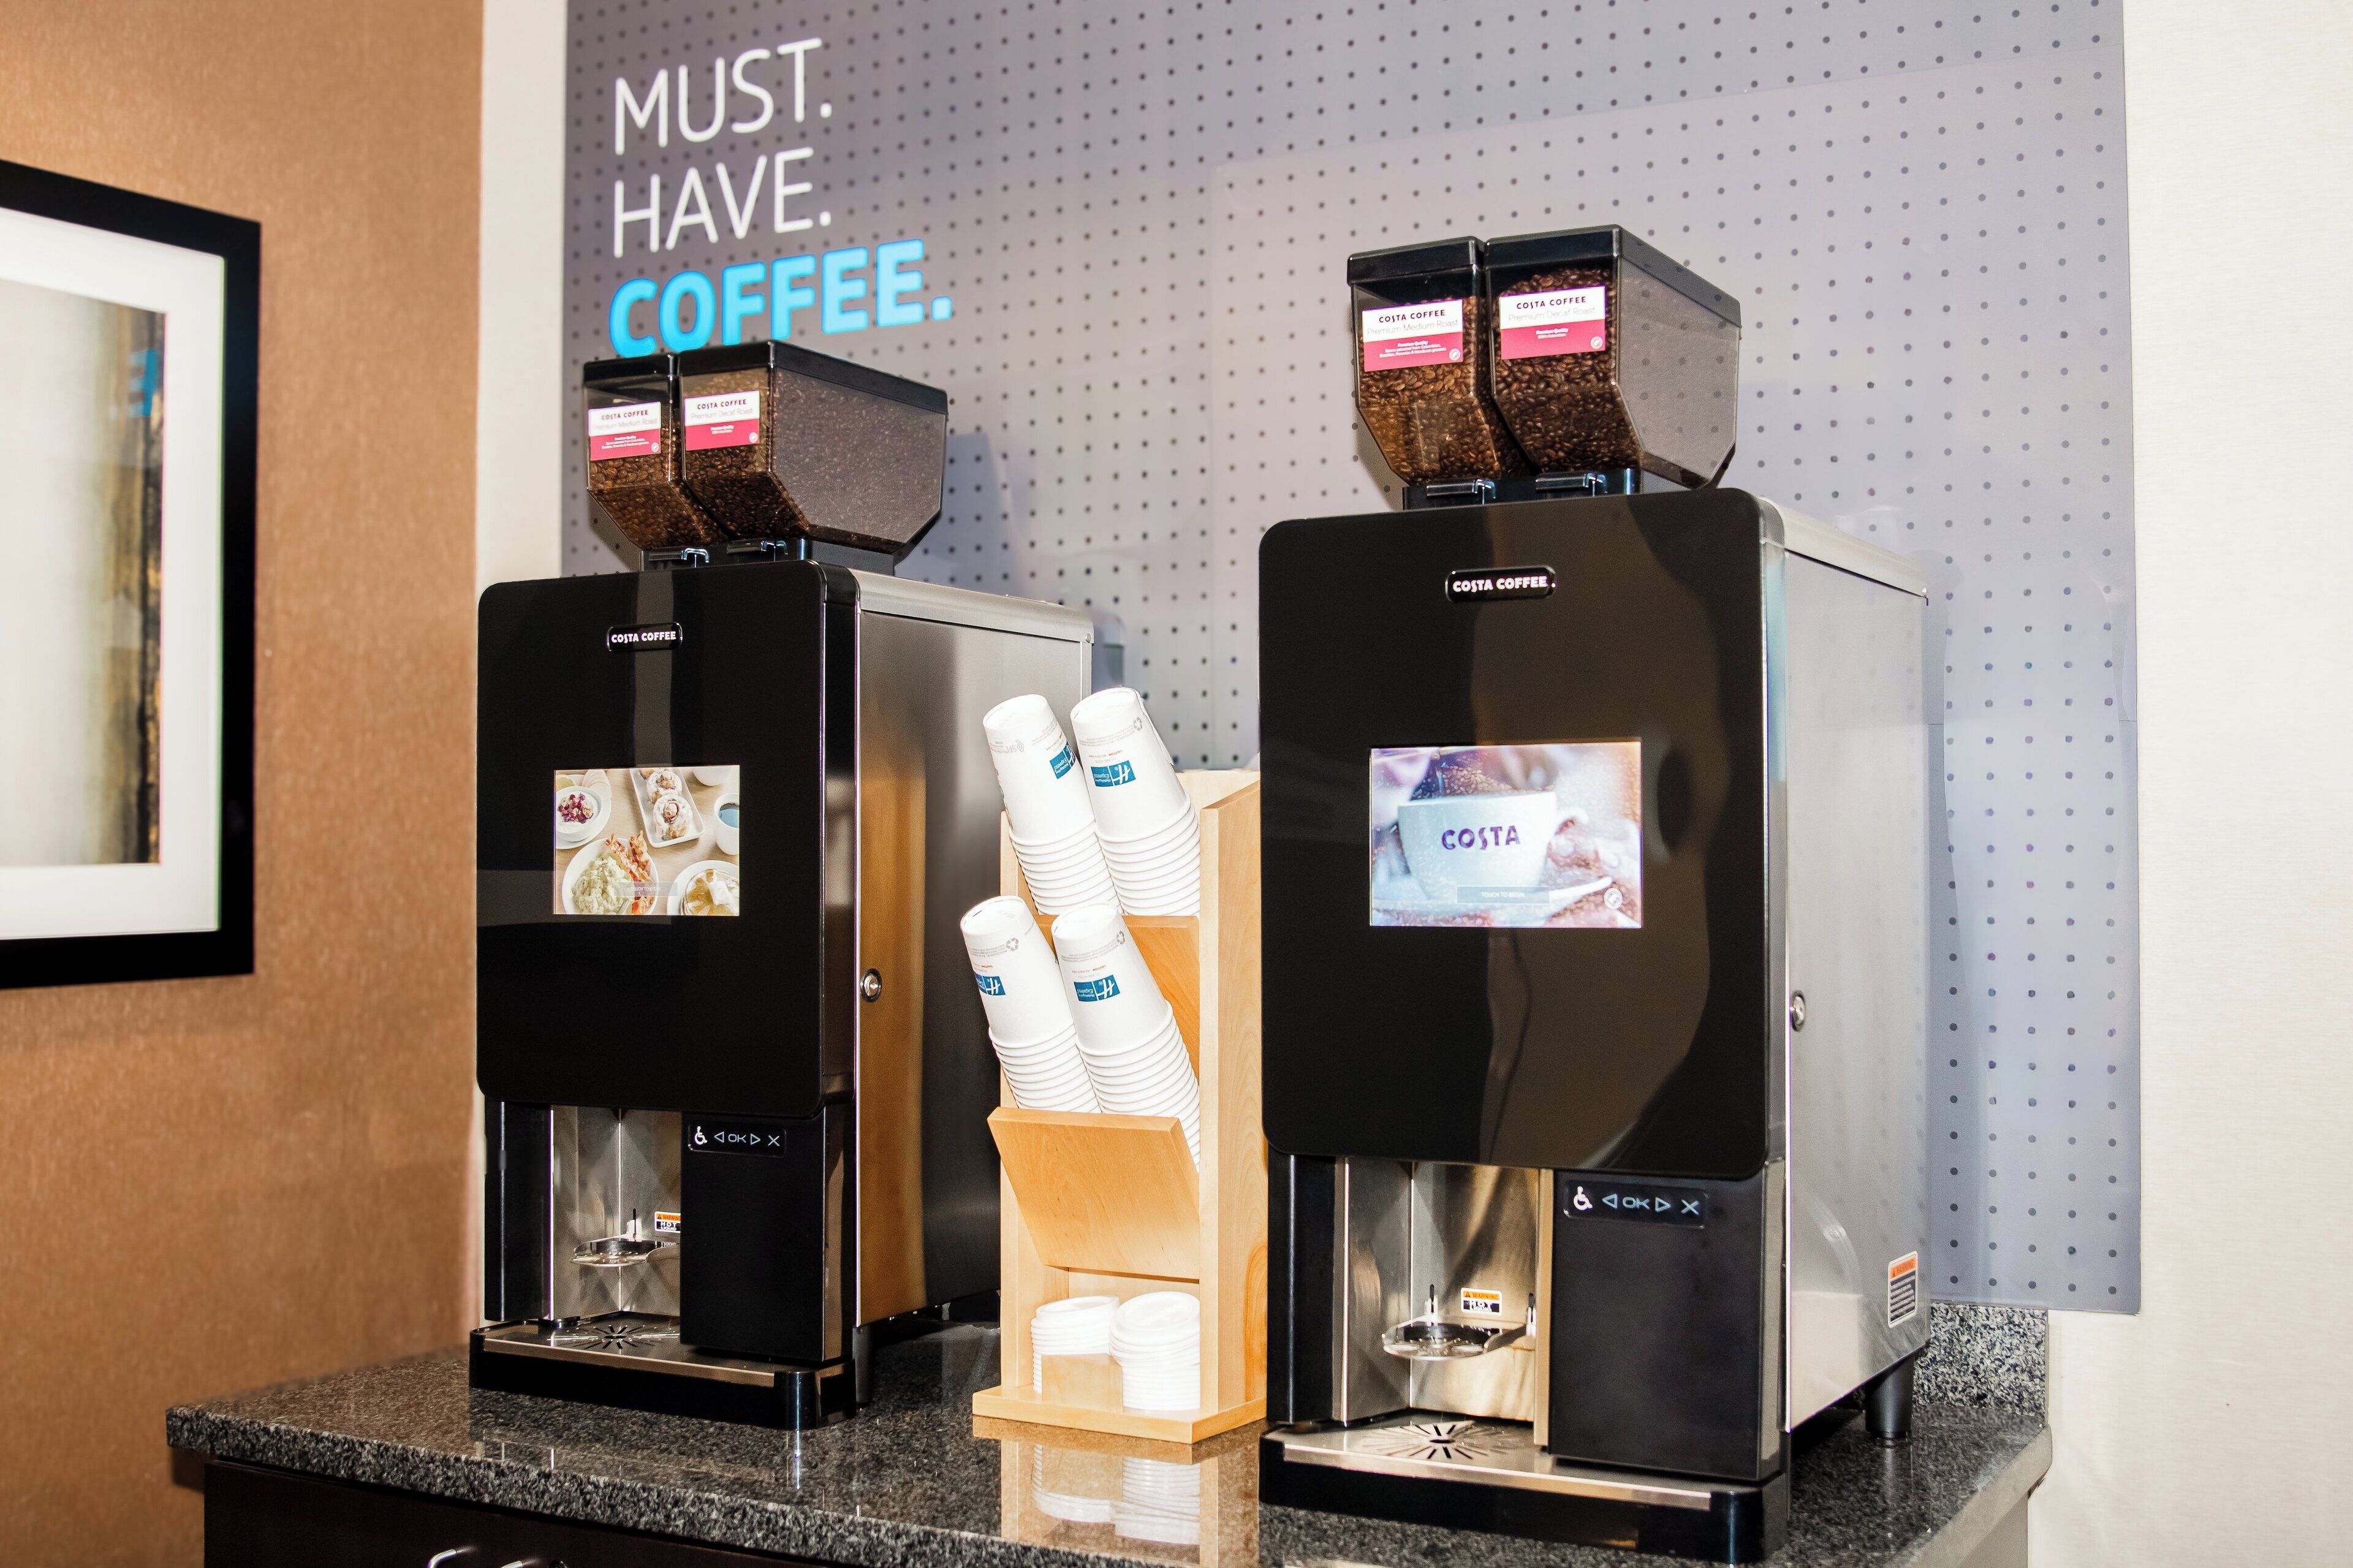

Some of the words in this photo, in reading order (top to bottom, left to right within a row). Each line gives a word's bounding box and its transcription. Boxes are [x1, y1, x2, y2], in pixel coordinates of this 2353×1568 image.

[615, 37, 832, 155] MUST.
[613, 147, 831, 258] HAVE.
[609, 238, 952, 358] COFFEE.
[1517, 301, 1545, 309] COSTA
[1550, 297, 1586, 306] COFFEE
[1379, 314, 1406, 323] COSTA
[1411, 309, 1446, 319] COFFEE
[1367, 326, 1401, 335] Premium
[1403, 323, 1434, 332] Medium
[1436, 319, 1458, 328] Roast
[1453, 579, 1493, 593] COSTA
[1496, 576, 1548, 590] COFFEE
[611, 633, 639, 644] COSTA
[641, 631, 676, 642] COFFEE
[1441, 825, 1520, 850] COSTA
[728, 1134, 747, 1143] OK
[1623, 1196, 1651, 1210] OK
